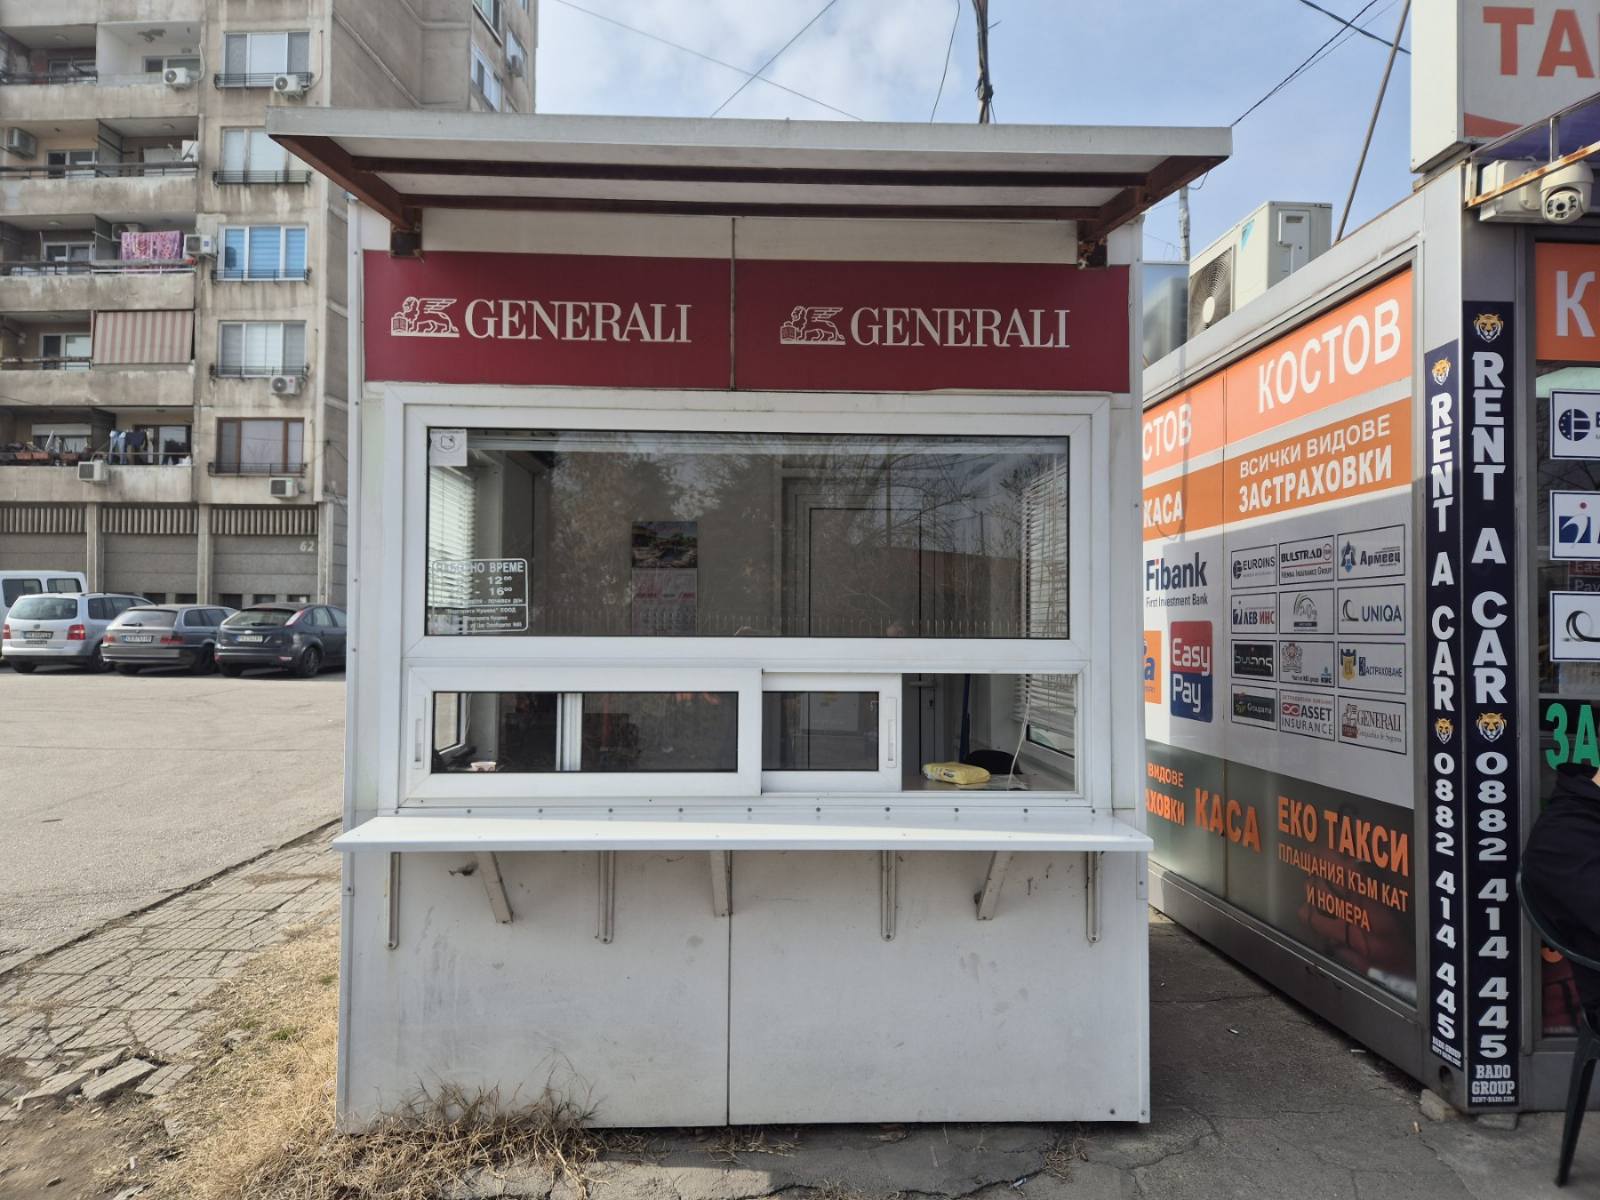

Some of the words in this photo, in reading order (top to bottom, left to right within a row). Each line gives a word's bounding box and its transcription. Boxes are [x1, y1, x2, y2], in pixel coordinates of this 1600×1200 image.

[1482, 6, 1600, 79] ТА
[464, 299, 692, 343] GENERALI
[850, 306, 1071, 348] GENERALI
[1258, 298, 1401, 414] КОСТОВ
[1239, 443, 1301, 479] ВСИЧКИ
[1306, 413, 1391, 458] ВИДОВЕ
[1471, 351, 1506, 501] RENT
[1238, 445, 1393, 513] ЗАСТРАХОВКИ
[1430, 391, 1454, 532] RENT
[1143, 490, 1183, 529] КАСА
[299, 540, 315, 552] 62
[1242, 556, 1276, 571] EUROINS
[1281, 547, 1323, 563] BULSTRAD
[1360, 550, 1401, 567] Армеец
[1471, 528, 1507, 565] A
[489, 562, 524, 573] ВРЕМЕ
[1146, 551, 1208, 592] Fibank
[1431, 551, 1455, 587] A
[1192, 592, 1208, 606] Bank
[1259, 609, 1275, 625] ИНС
[1361, 604, 1402, 622] UNIQA
[1172, 637, 1211, 677] Easy
[1431, 604, 1456, 712] CAR
[1471, 591, 1508, 704] CAR
[1172, 673, 1202, 713] Pay
[1301, 704, 1333, 722] ASSET
[1281, 717, 1334, 736] INSURANCE
[1357, 709, 1401, 732] GENERALI
[1147, 762, 1185, 788] ВИДОВЕ
[1194, 787, 1262, 854] КАСА
[1433, 751, 1455, 858] 0882
[1475, 751, 1508, 862] 0882
[1277, 795, 1318, 843] ЕКО
[1324, 809, 1409, 877] ТАКСИ
[1278, 843, 1345, 888] ПЛАЩАНИЯ
[1347, 871, 1378, 901] КЪМ
[1381, 883, 1409, 913] КАТ
[1306, 884, 1316, 904] И
[1317, 892, 1371, 932] НОМЕРА
[1434, 869, 1457, 950] 414
[1477, 878, 1509, 960] 414
[1435, 961, 1457, 1041] 445
[1478, 976, 1509, 1059] 445
[1471, 1080, 1516, 1095] GROUP
[1475, 1064, 1511, 1079] BADO
